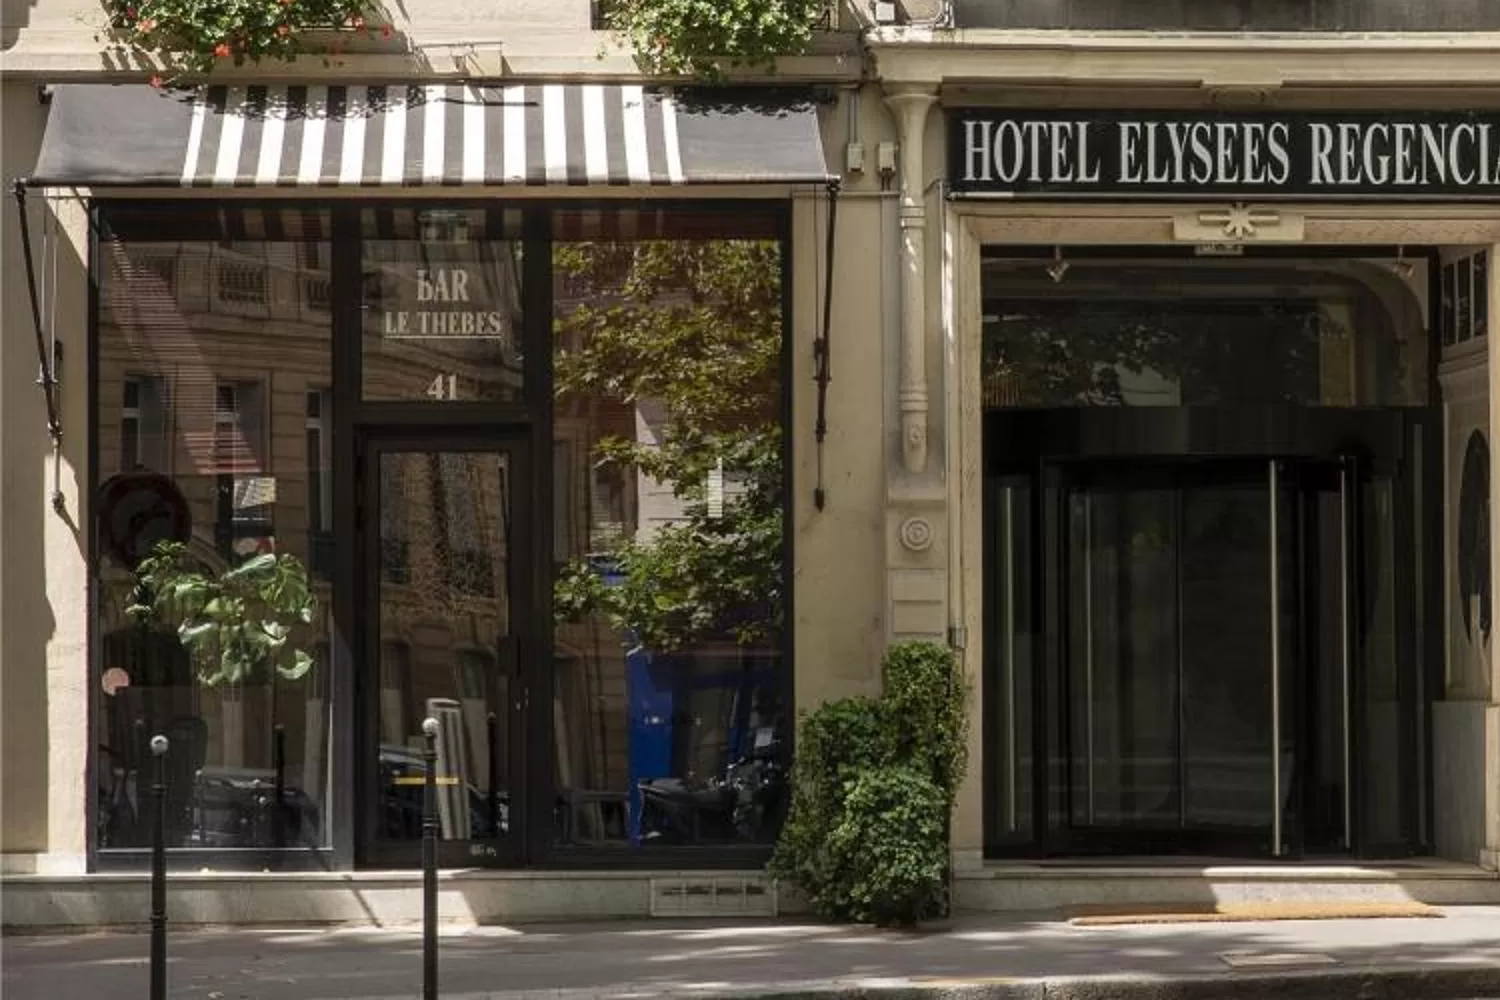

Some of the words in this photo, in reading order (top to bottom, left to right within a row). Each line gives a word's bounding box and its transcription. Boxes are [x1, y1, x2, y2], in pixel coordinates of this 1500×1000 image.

[963, 120, 1100, 183] HOTEL
[1116, 122, 1290, 184] ELYSEES
[416, 268, 470, 302] BAR
[384, 311, 410, 334] LE
[418, 311, 502, 335] THEBES
[427, 374, 458, 401] 41
